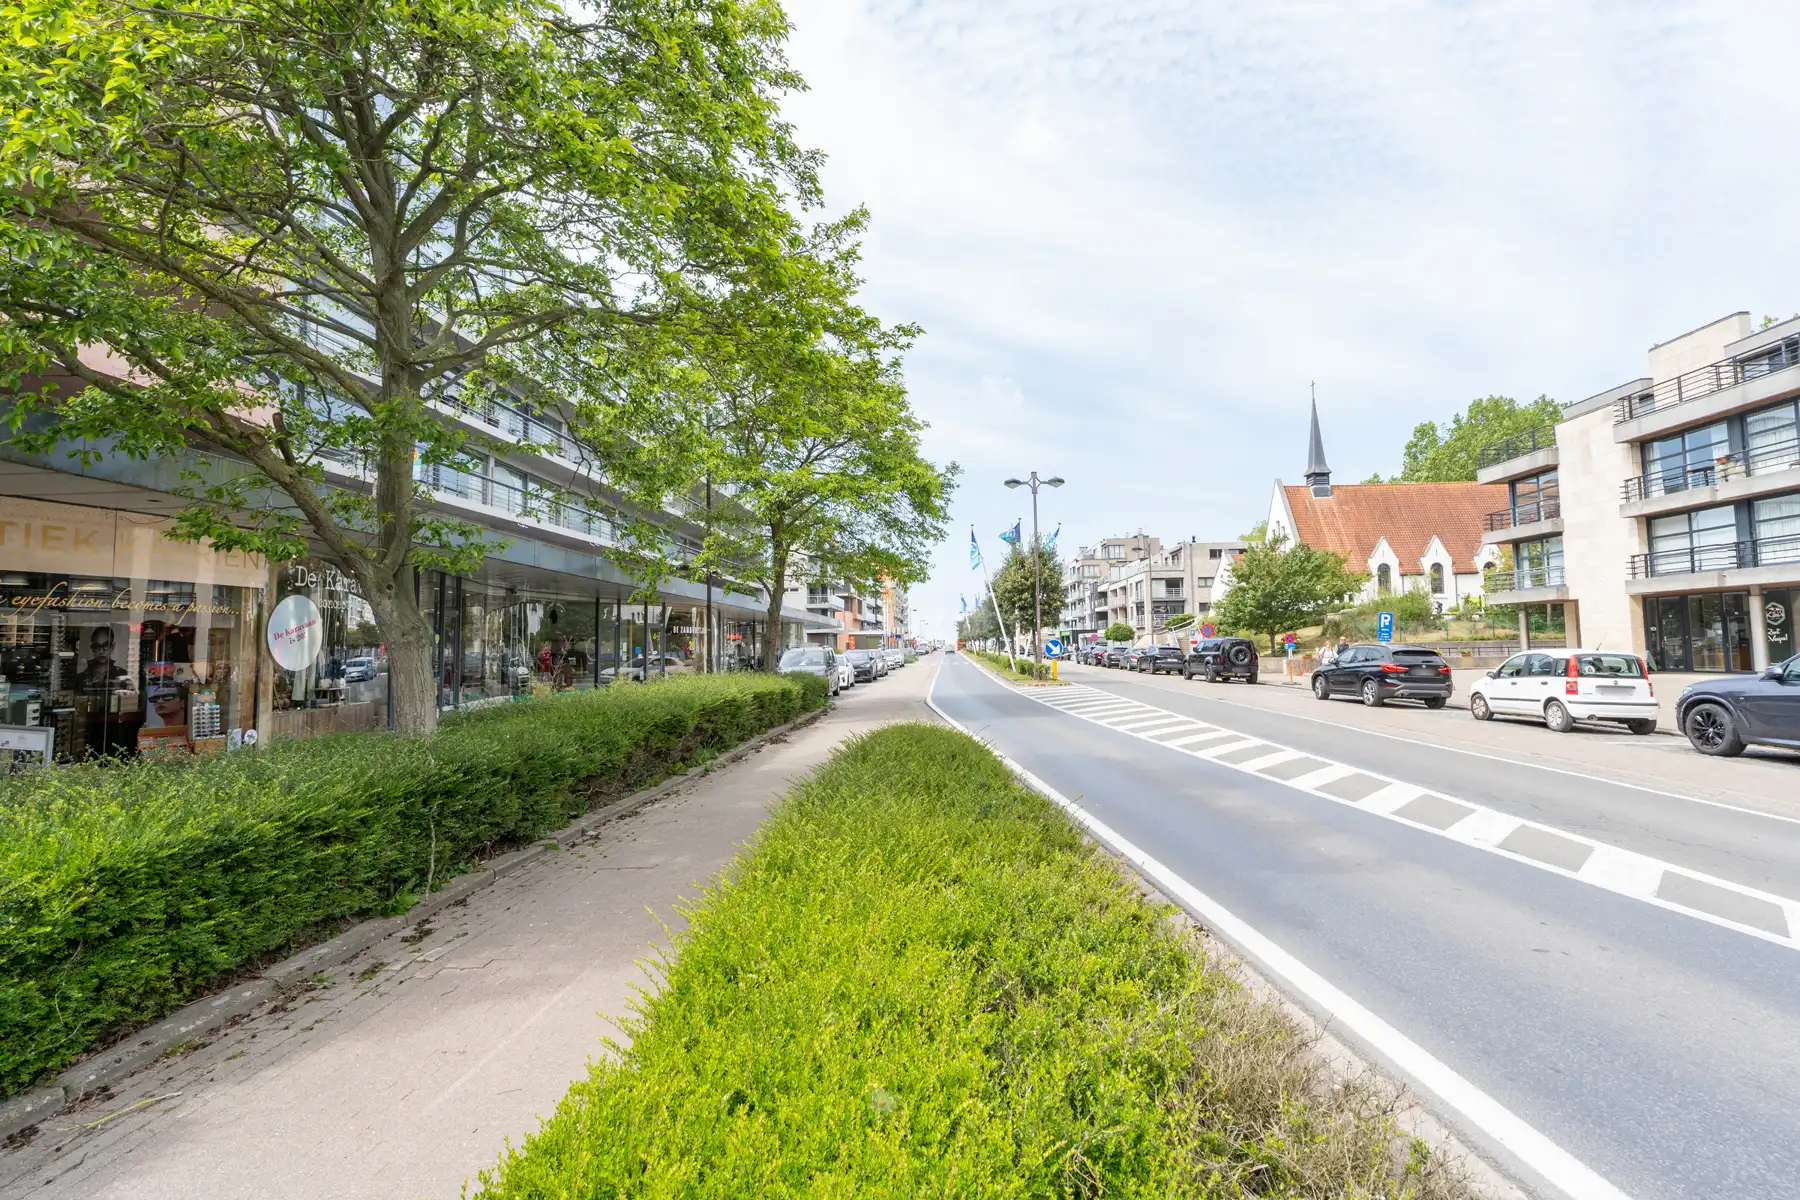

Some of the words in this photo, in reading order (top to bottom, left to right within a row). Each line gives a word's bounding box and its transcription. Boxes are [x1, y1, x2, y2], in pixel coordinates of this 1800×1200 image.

[295, 565, 317, 588] De
[1, 581, 108, 623] eyefashion
[111, 587, 168, 612] becomes
[172, 603, 185, 612] a
[273, 632, 284, 640] De
[284, 619, 317, 636] Karavaan
[1380, 614, 1391, 628] P
[289, 637, 296, 645] is
